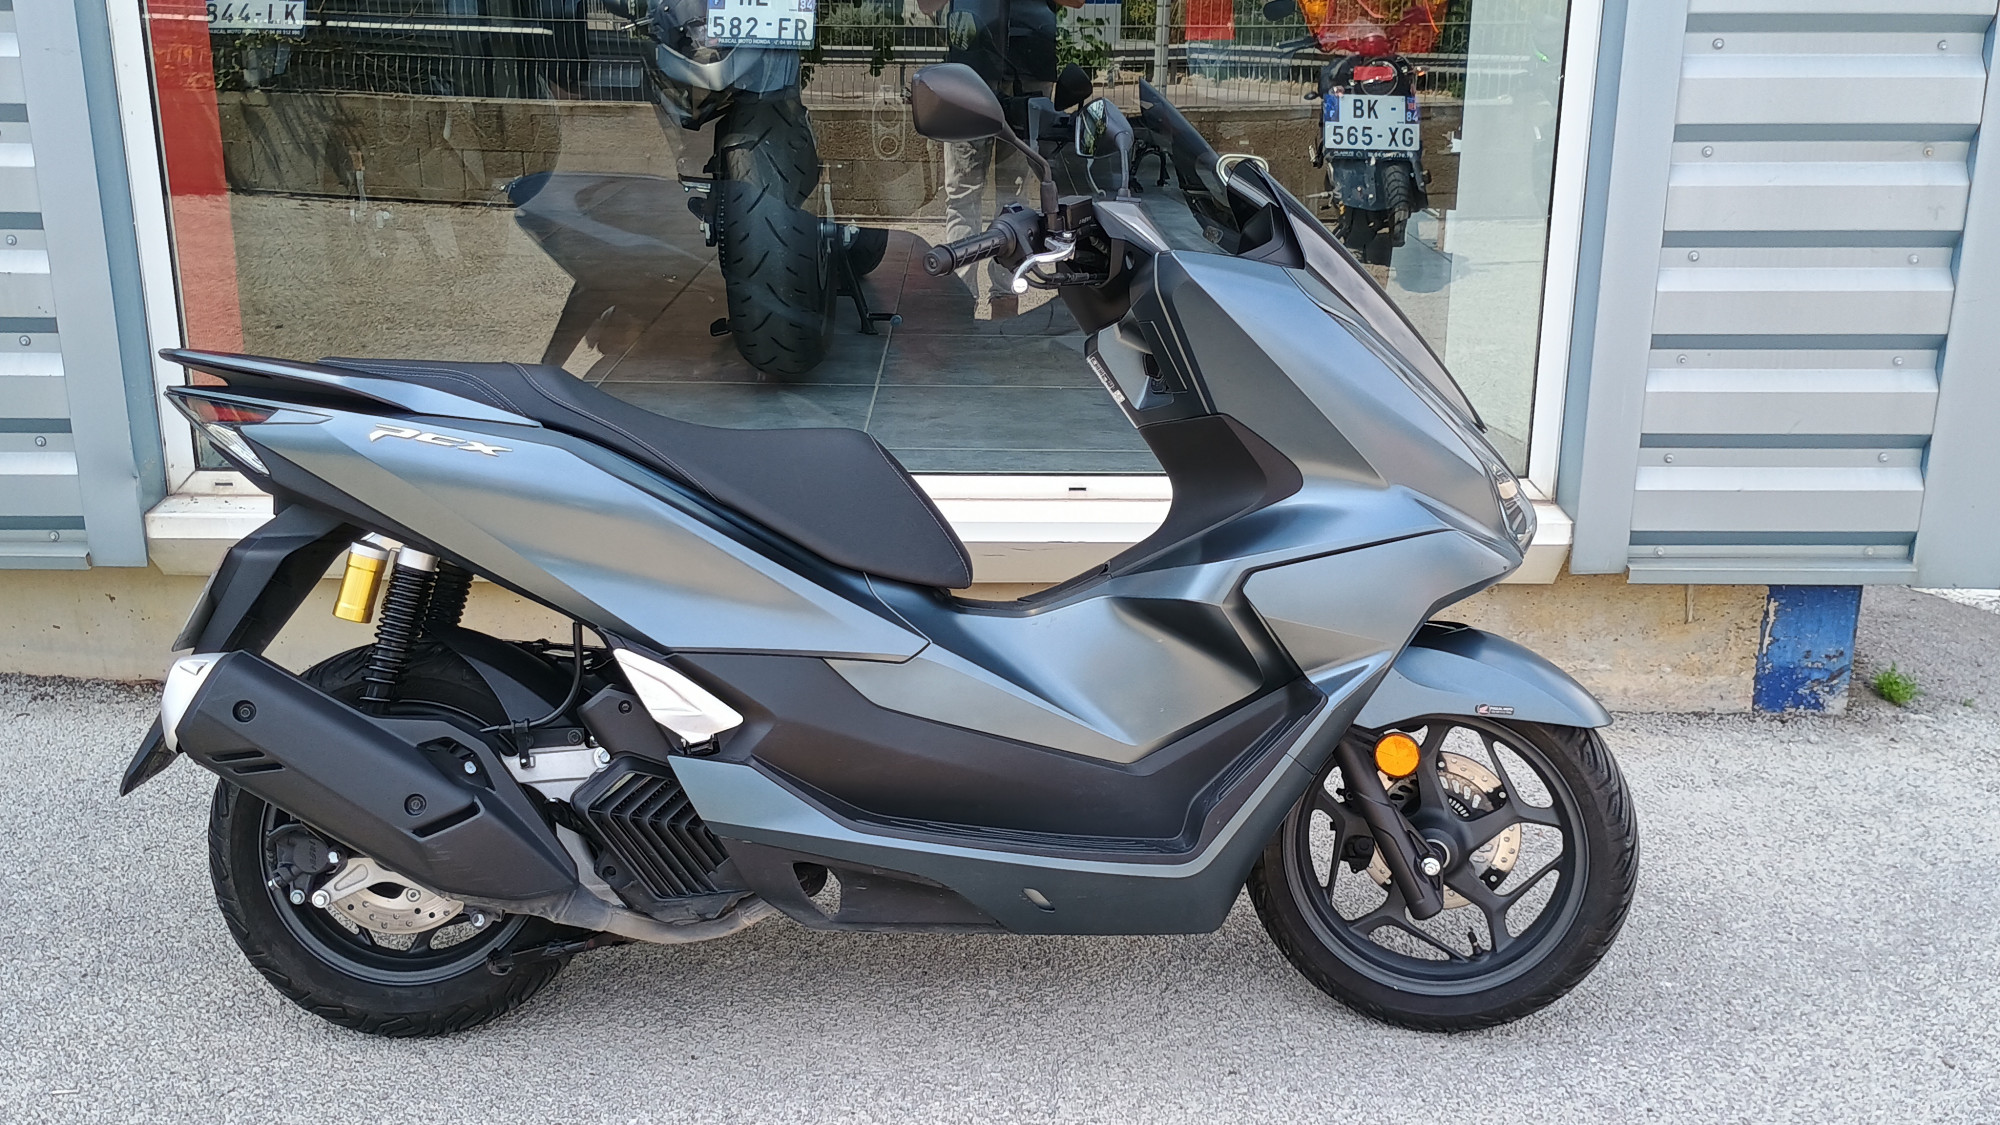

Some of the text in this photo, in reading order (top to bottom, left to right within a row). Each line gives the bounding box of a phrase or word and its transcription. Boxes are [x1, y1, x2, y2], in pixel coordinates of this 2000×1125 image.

[713, 16, 808, 40] 582-FR
[1332, 125, 1414, 148] 565-XG
[369, 423, 513, 457] PCX
